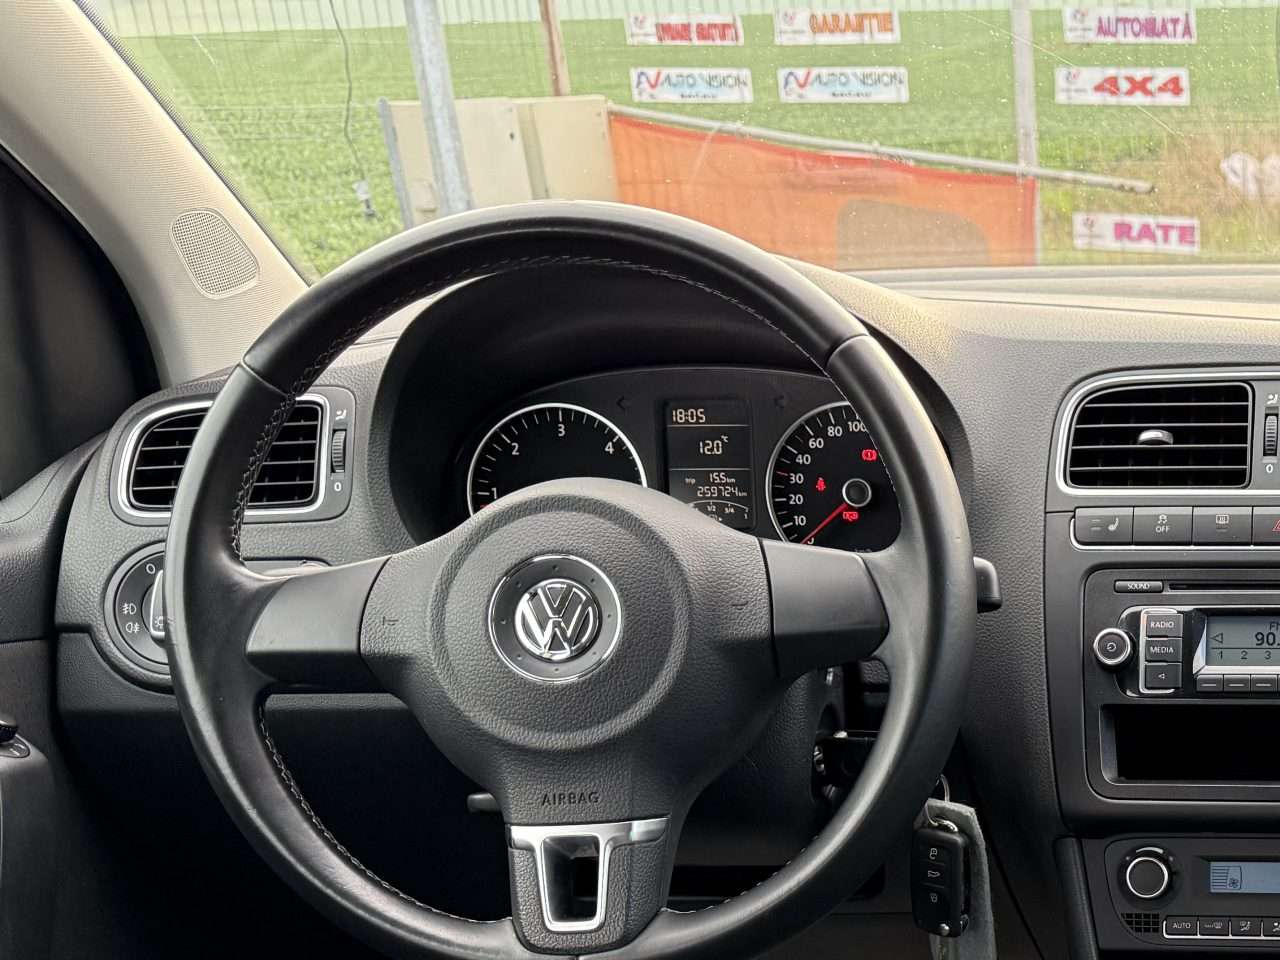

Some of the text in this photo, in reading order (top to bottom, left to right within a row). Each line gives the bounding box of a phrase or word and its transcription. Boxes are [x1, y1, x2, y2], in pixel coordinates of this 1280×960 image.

[1114, 222, 1196, 245] RATE
[673, 409, 706, 423] 18:05
[558, 424, 566, 437] 3
[827, 426, 843, 437] 80
[847, 421, 867, 432] 100
[604, 442, 615, 454] 4
[808, 438, 824, 449] 60
[512, 443, 520, 456] 2
[795, 454, 811, 465] 40
[789, 473, 804, 484] 30
[491, 488, 498, 500] 1
[789, 494, 804, 505] 20
[793, 515, 806, 526] 10
[1156, 526, 1170, 534] OFF
[1127, 582, 1151, 590] SOUND
[1150, 621, 1175, 629] RADIO
[1218, 651, 1223, 660] 1
[1240, 651, 1248, 660] 2
[1264, 651, 1272, 660] 3
[542, 792, 599, 806] AIRBAG
